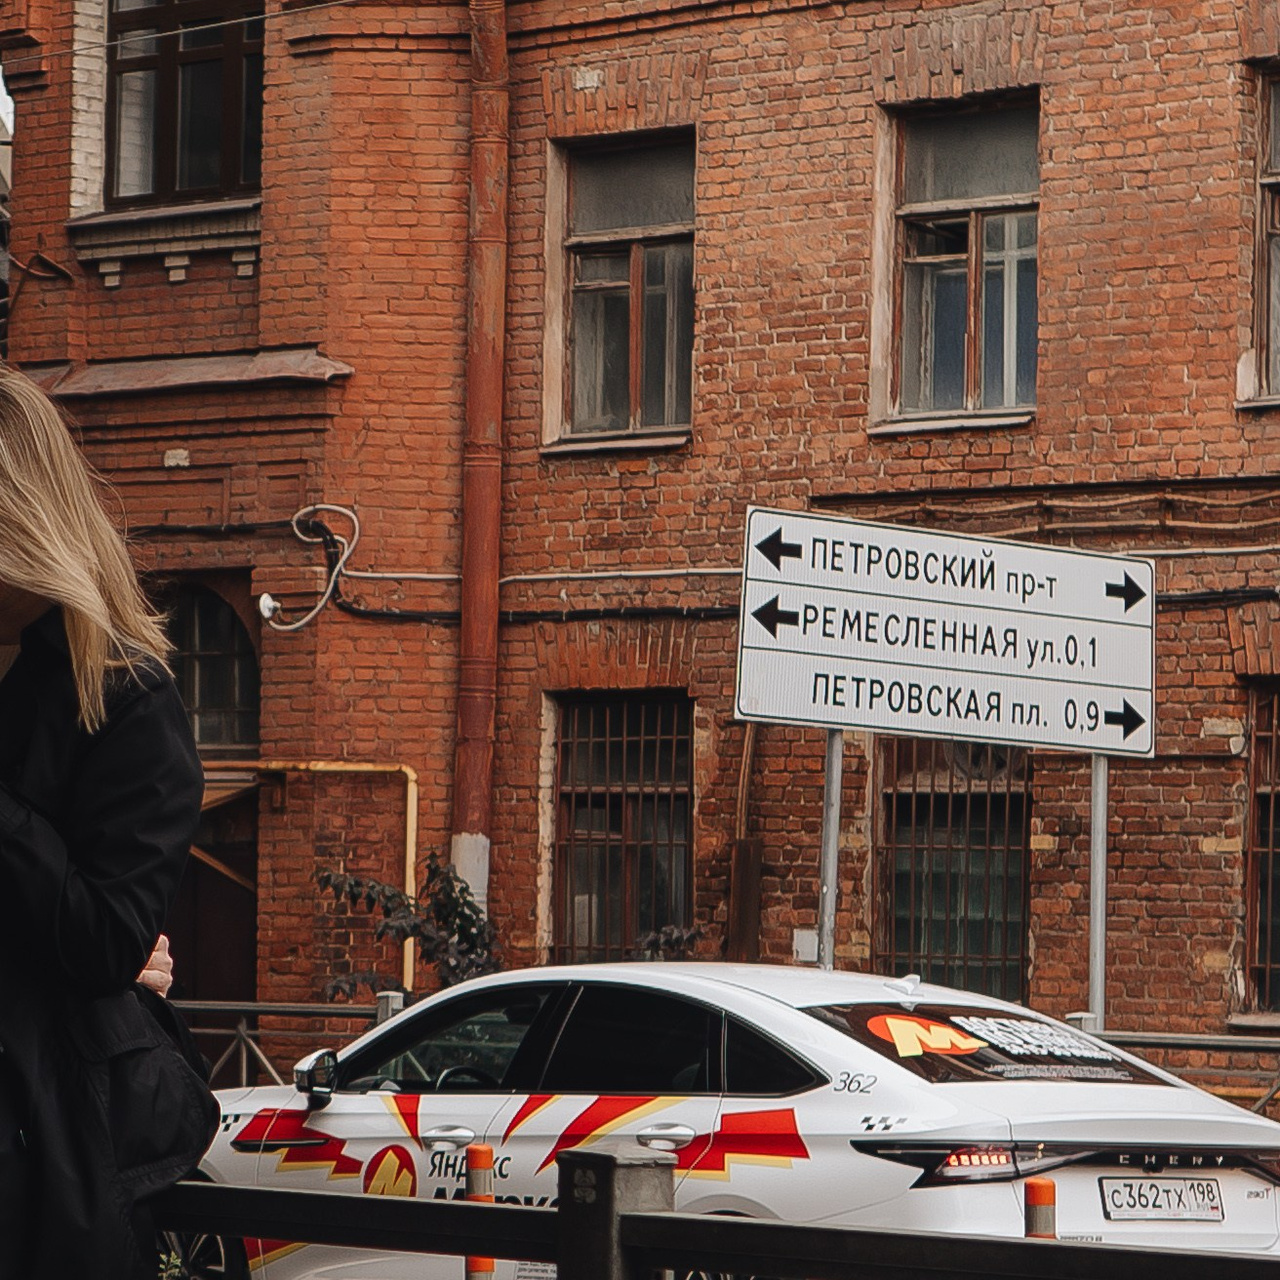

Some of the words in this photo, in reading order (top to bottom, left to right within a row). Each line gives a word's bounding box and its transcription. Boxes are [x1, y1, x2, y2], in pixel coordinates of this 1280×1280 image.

[811, 537, 995, 591] ПЕТРОВСКИЙ
[1006, 572, 1058, 604] пр-т
[802, 604, 1017, 659] РЕМЕСЛЕННАЯ
[812, 672, 1001, 723] ПЕТРОВСКАЯ
[1011, 702, 1048, 727] пл.
[1064, 699, 1100, 733] 0,9
[834, 1071, 878, 1094] 362
[1119, 1154, 1224, 1166] CHERY
[1189, 1182, 1216, 1202] 198
